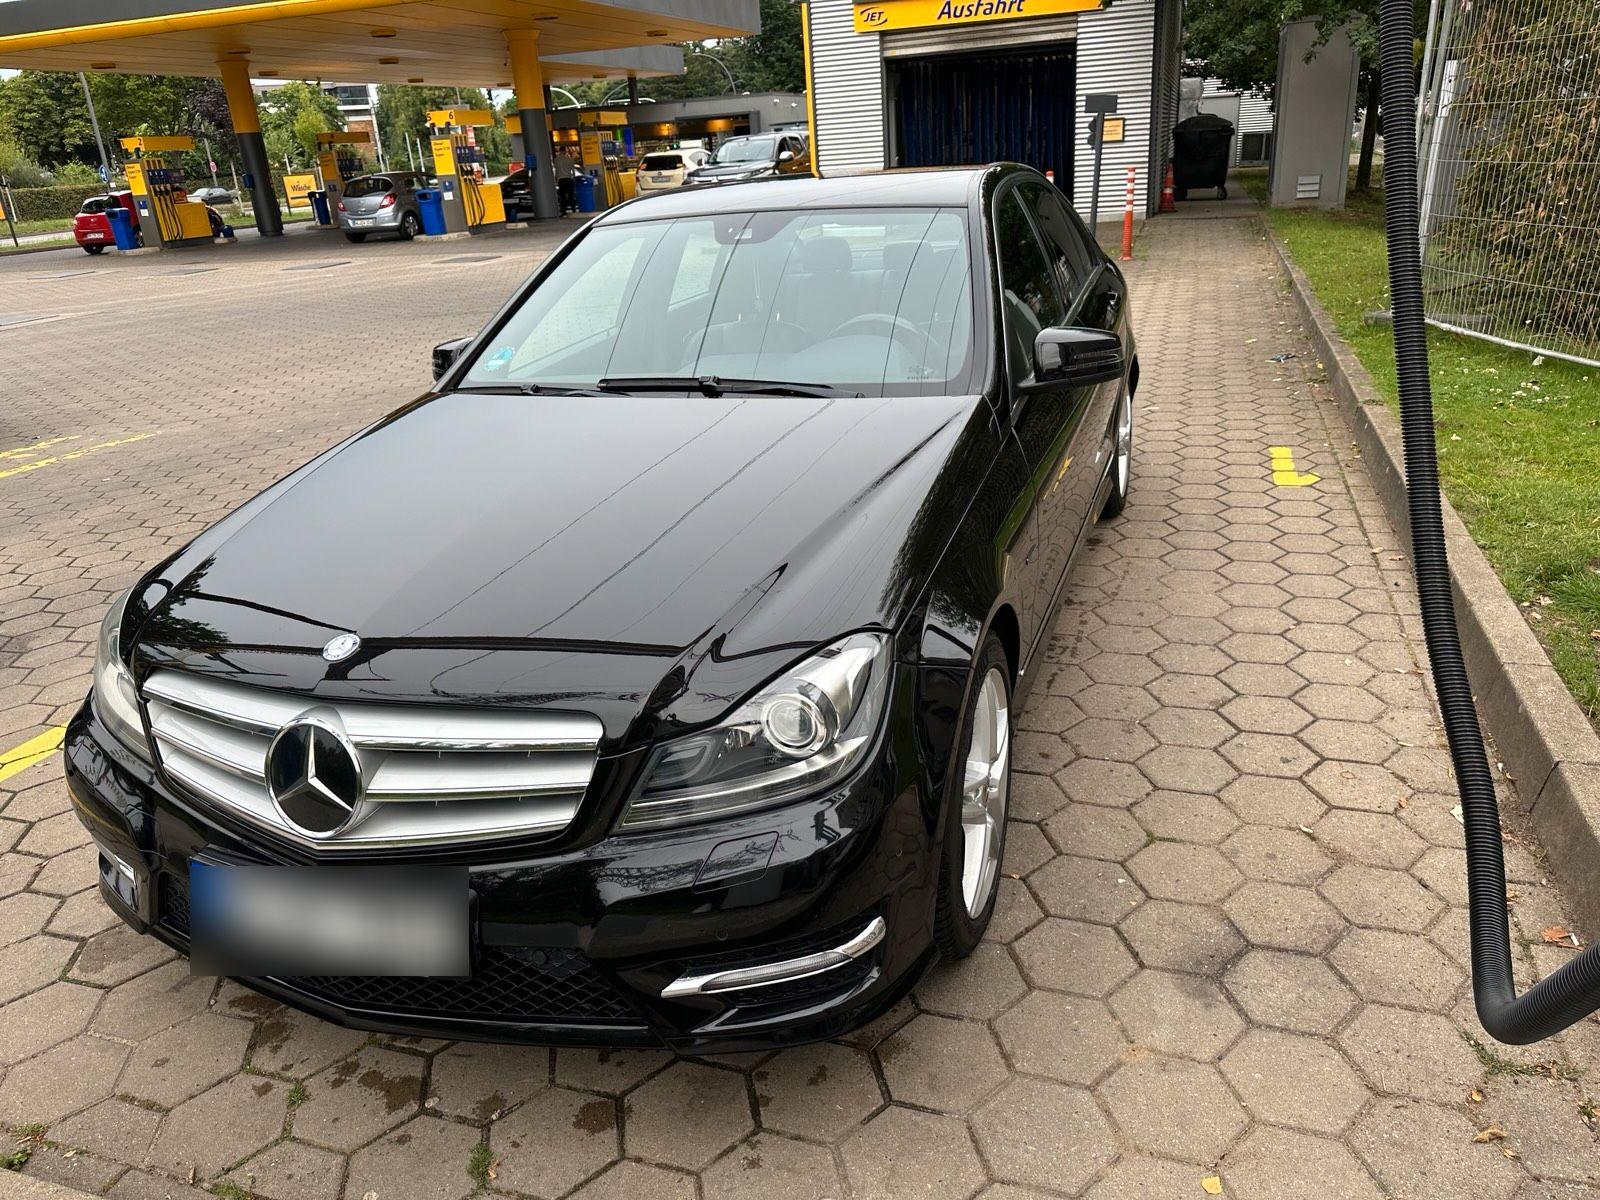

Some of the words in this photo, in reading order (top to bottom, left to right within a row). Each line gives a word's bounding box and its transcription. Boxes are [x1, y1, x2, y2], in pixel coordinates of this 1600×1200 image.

[937, 0, 1025, 20] Ausfahrt
[864, 11, 884, 22] JET
[426, 113, 432, 121] 5
[448, 111, 454, 119] 6
[137, 137, 143, 146] 2
